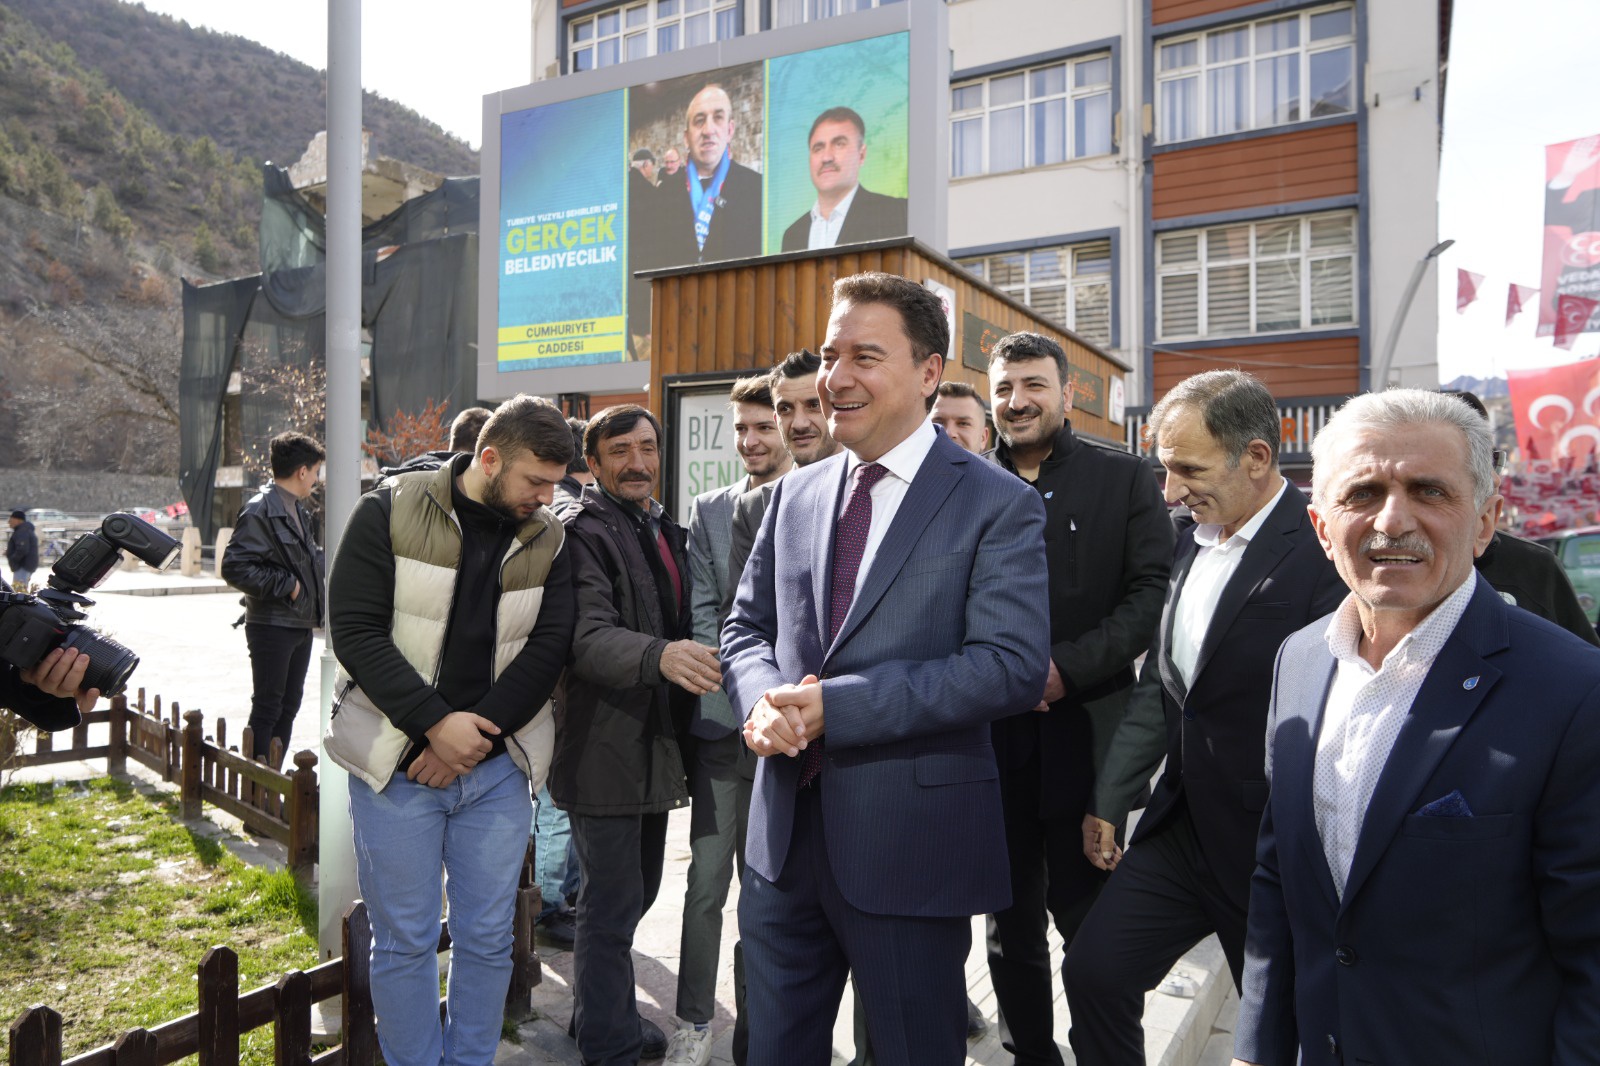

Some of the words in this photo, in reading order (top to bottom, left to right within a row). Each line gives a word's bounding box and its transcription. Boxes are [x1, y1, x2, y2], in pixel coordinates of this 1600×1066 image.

[506, 213, 617, 255] GERÇEK
[505, 245, 617, 275] BELEDİYECİLİK
[688, 408, 724, 451] BİZ
[688, 453, 747, 498] SENİ
